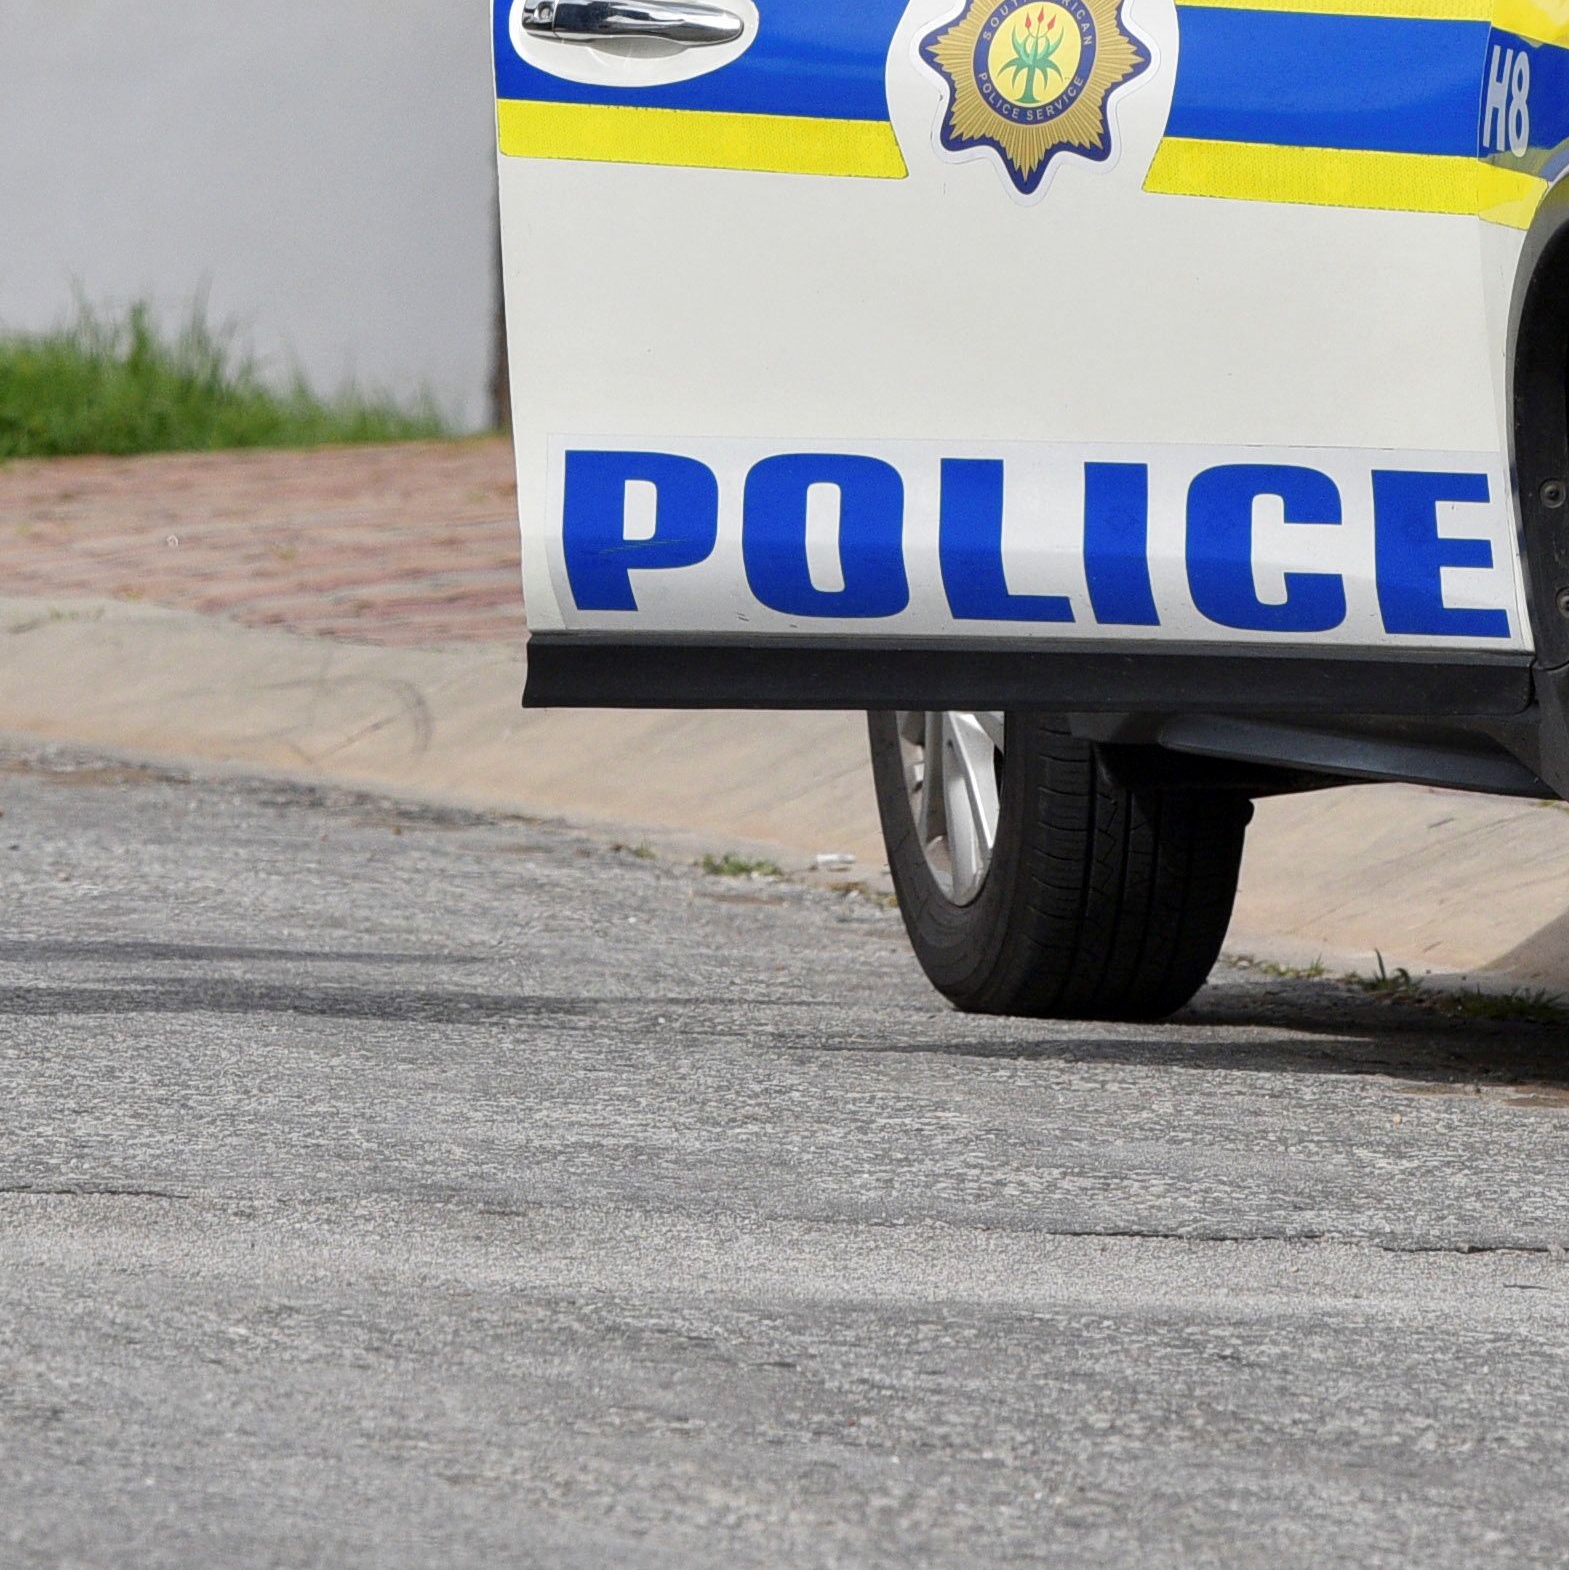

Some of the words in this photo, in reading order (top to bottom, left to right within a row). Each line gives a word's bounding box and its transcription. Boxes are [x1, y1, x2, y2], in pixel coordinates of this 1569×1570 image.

[977, 71, 1020, 120] POLICE
[1026, 76, 1084, 121] SERVICE
[1482, 44, 1531, 158] H8
[562, 449, 1512, 640] POLICE
